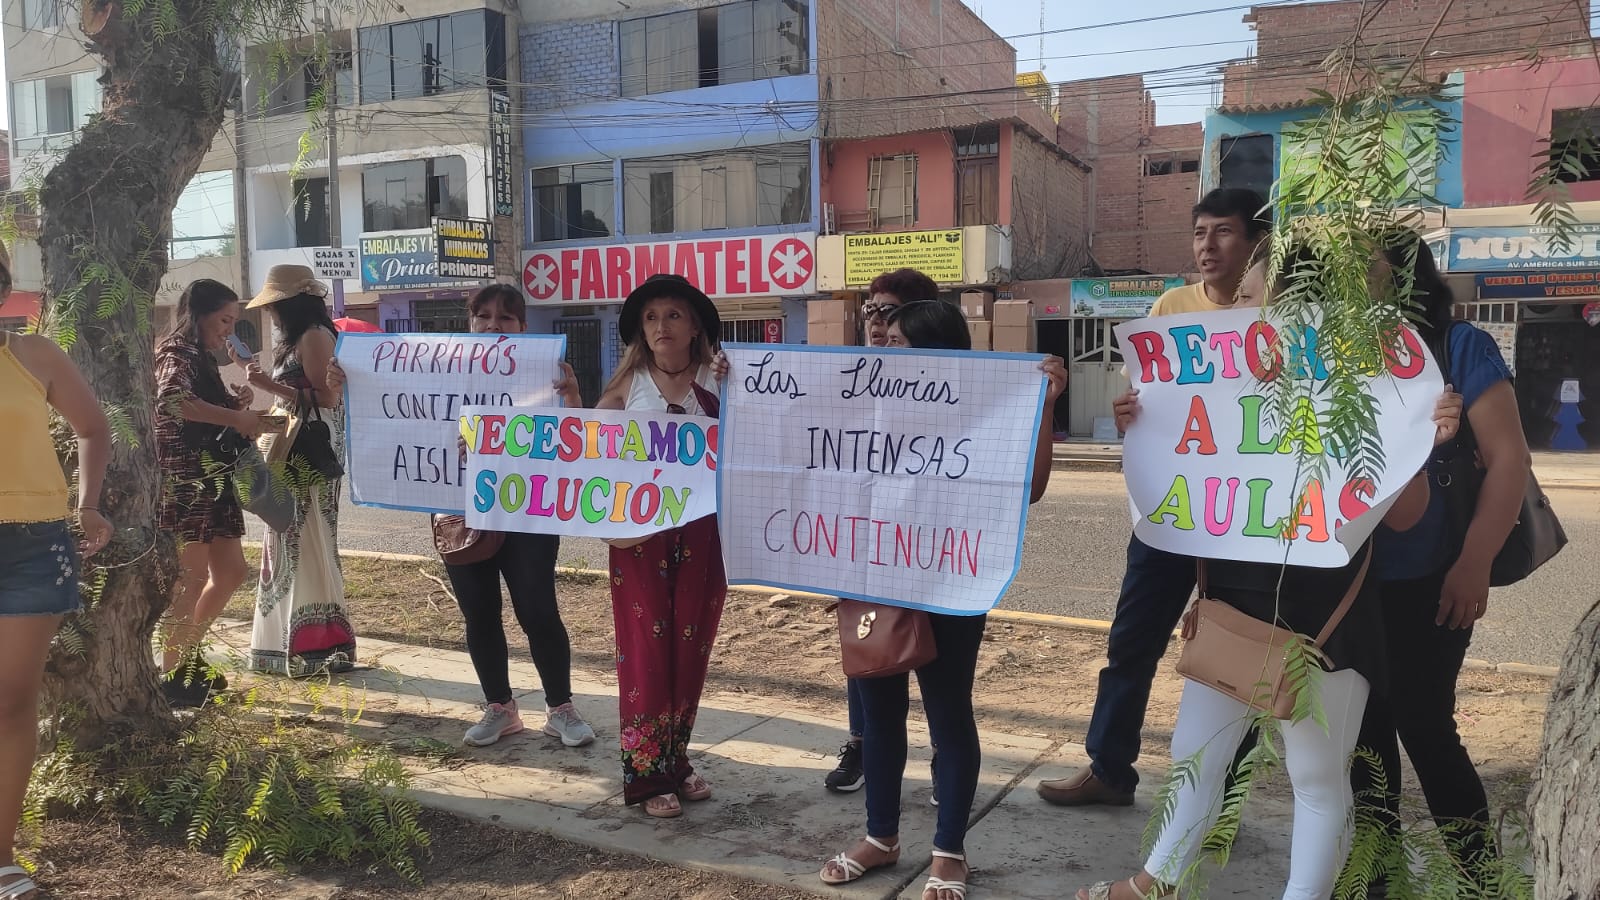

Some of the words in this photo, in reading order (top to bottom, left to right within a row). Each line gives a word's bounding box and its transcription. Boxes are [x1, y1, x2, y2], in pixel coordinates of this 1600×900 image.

[494, 101, 504, 203] EMBALAJES
[502, 123, 511, 204] MUDANZAS
[362, 237, 417, 255] EMBALAJES
[420, 236, 426, 253] Y
[439, 219, 485, 239] EMBALAJES
[486, 223, 492, 240] Y
[443, 239, 489, 259] MUDANZAS
[849, 235, 912, 247] EMBALAJES
[315, 251, 343, 259] CAJAS
[348, 250, 355, 258] X
[315, 261, 345, 269] MAYOR
[321, 269, 352, 277] MENOR
[381, 257, 434, 282] Princ
[440, 259, 495, 278] PRÍNCIPE
[561, 238, 770, 301] FARMATEL
[1527, 274, 1545, 284] DE
[1544, 286, 1555, 295] Y
[373, 336, 517, 376] PARRAPÓS
[1128, 320, 1425, 384] RETORO
[745, 352, 807, 399] Las
[460, 414, 719, 471] NECESITAMOS
[1175, 395, 1217, 455] A
[806, 427, 972, 479] INTENSAS
[474, 468, 691, 526] SOLUCIÓN
[1147, 474, 1377, 543] AULAS
[764, 509, 982, 577] CONTINUAN
